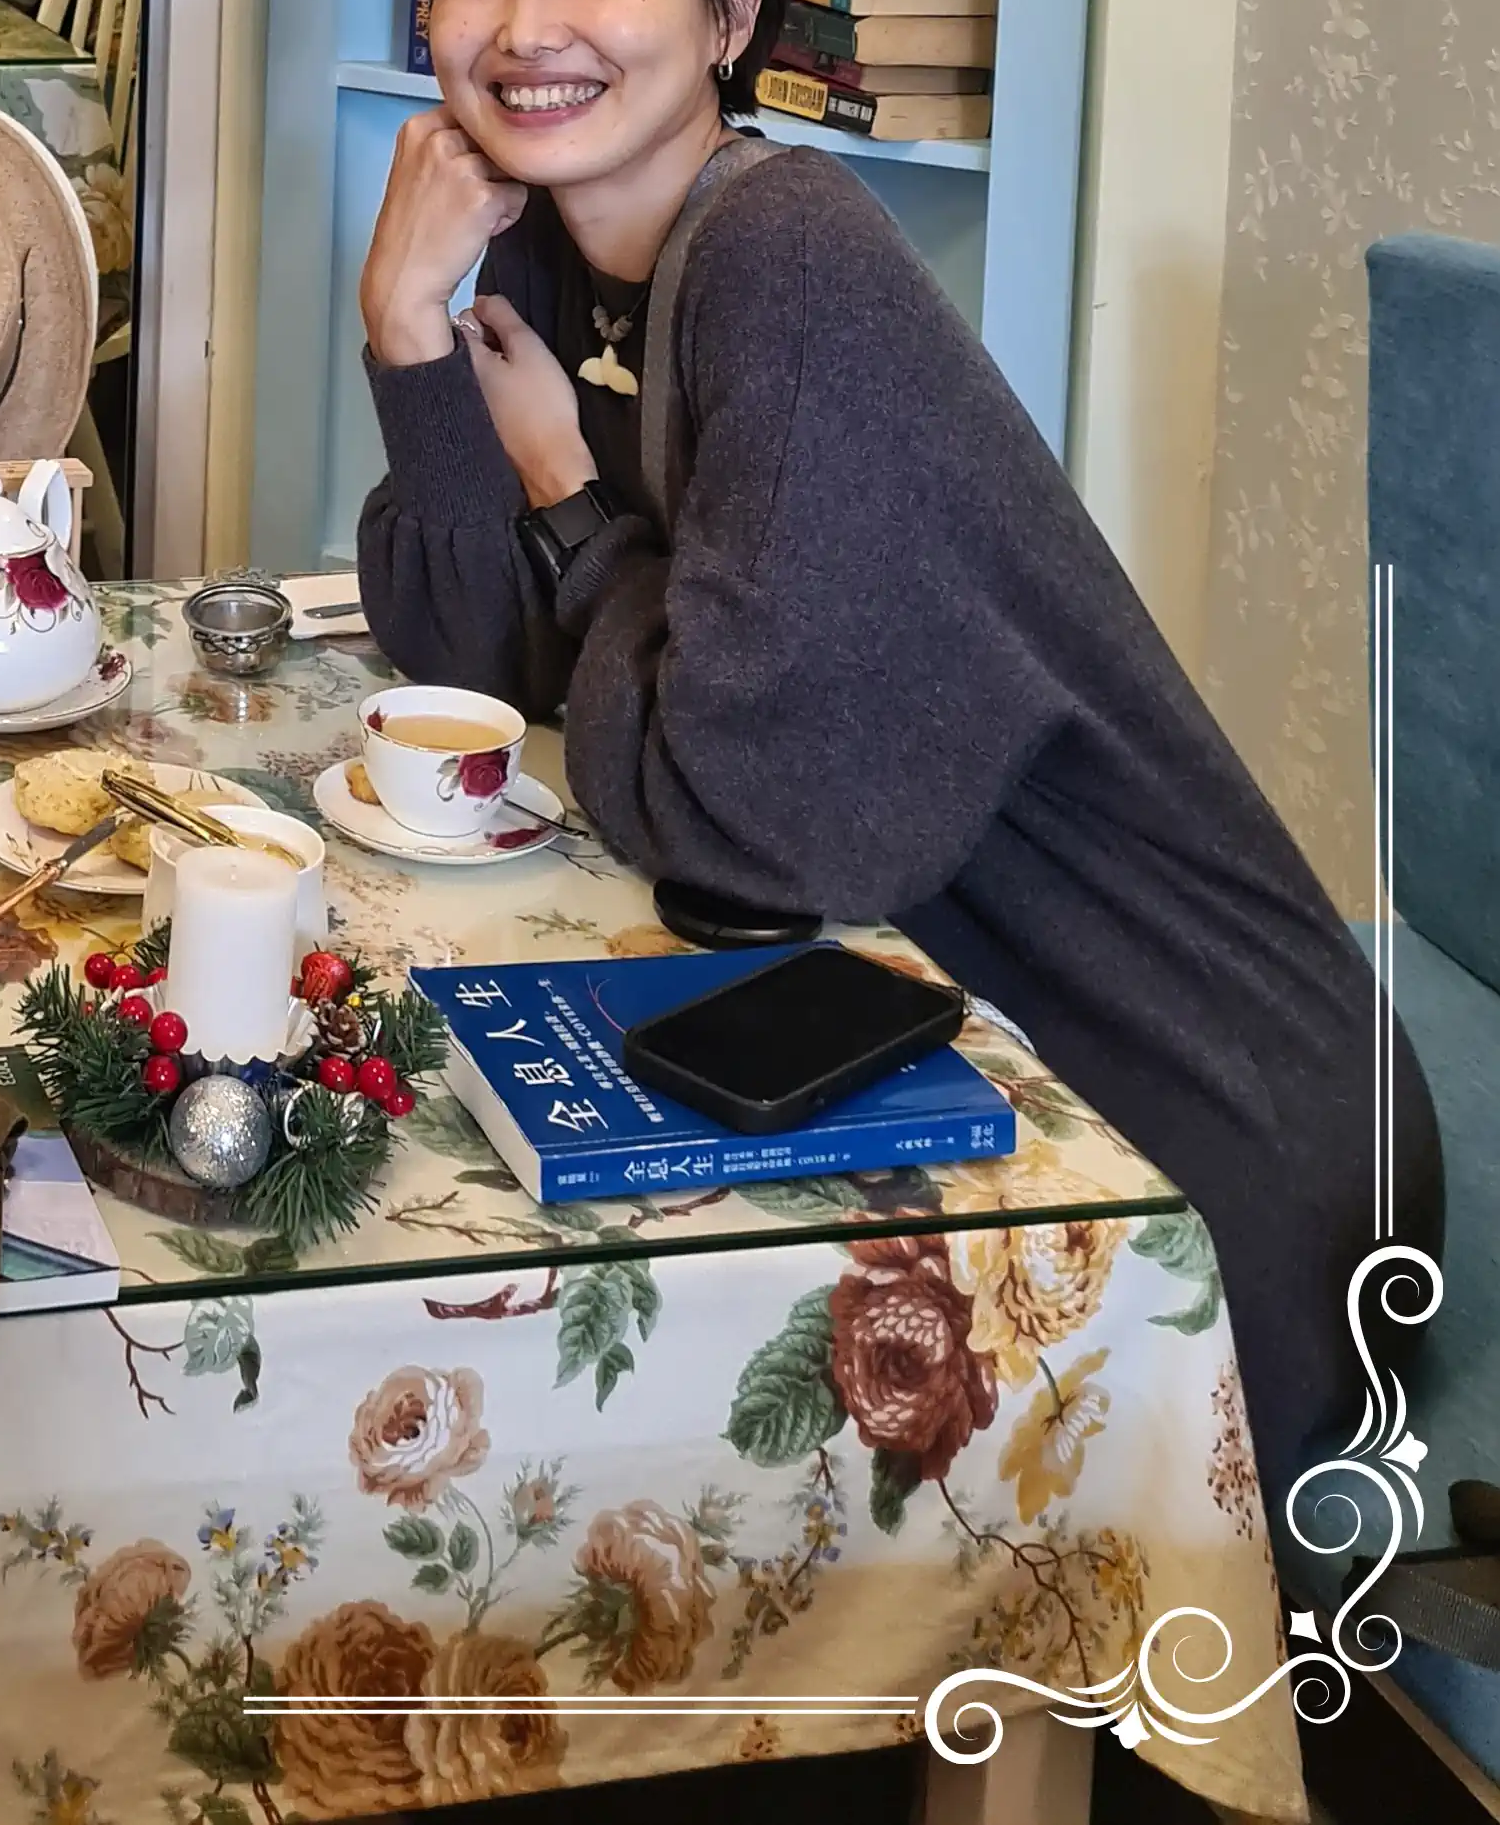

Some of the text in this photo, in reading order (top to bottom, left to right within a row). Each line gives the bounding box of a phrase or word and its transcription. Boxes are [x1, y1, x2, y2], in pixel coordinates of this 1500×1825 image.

[454, 978, 610, 1134] 全息人生
[623, 1153, 714, 1183] 全息人生
